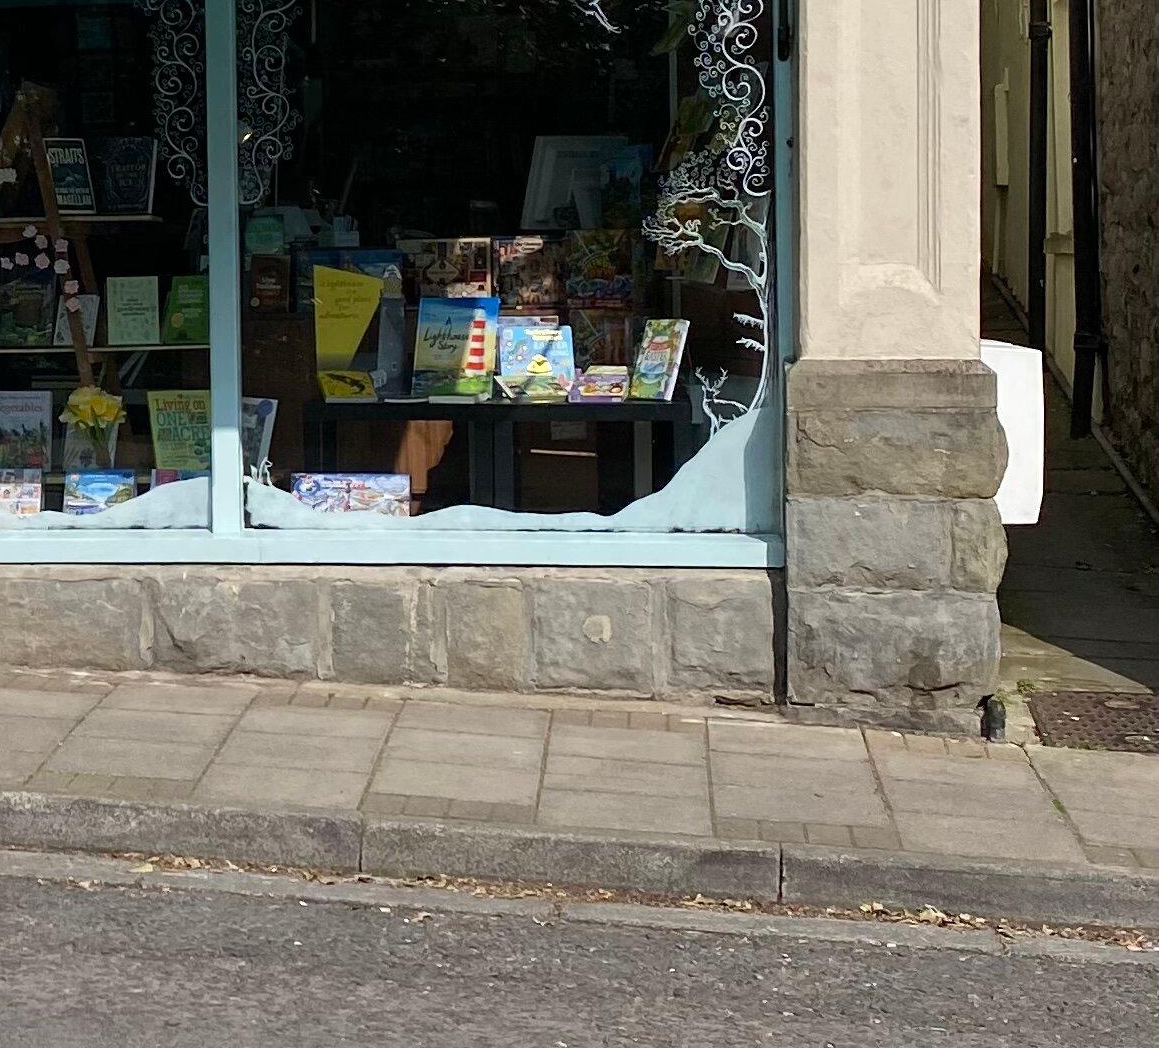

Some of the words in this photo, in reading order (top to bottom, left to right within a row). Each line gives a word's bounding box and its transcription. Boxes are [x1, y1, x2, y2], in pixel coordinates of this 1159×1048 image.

[47, 147, 85, 165] STRAITS
[445, 315, 452, 326] A
[423, 326, 470, 348] Lighthouse
[155, 398, 191, 414] Living
[192, 399, 207, 411] on
[156, 411, 187, 427] ONE
